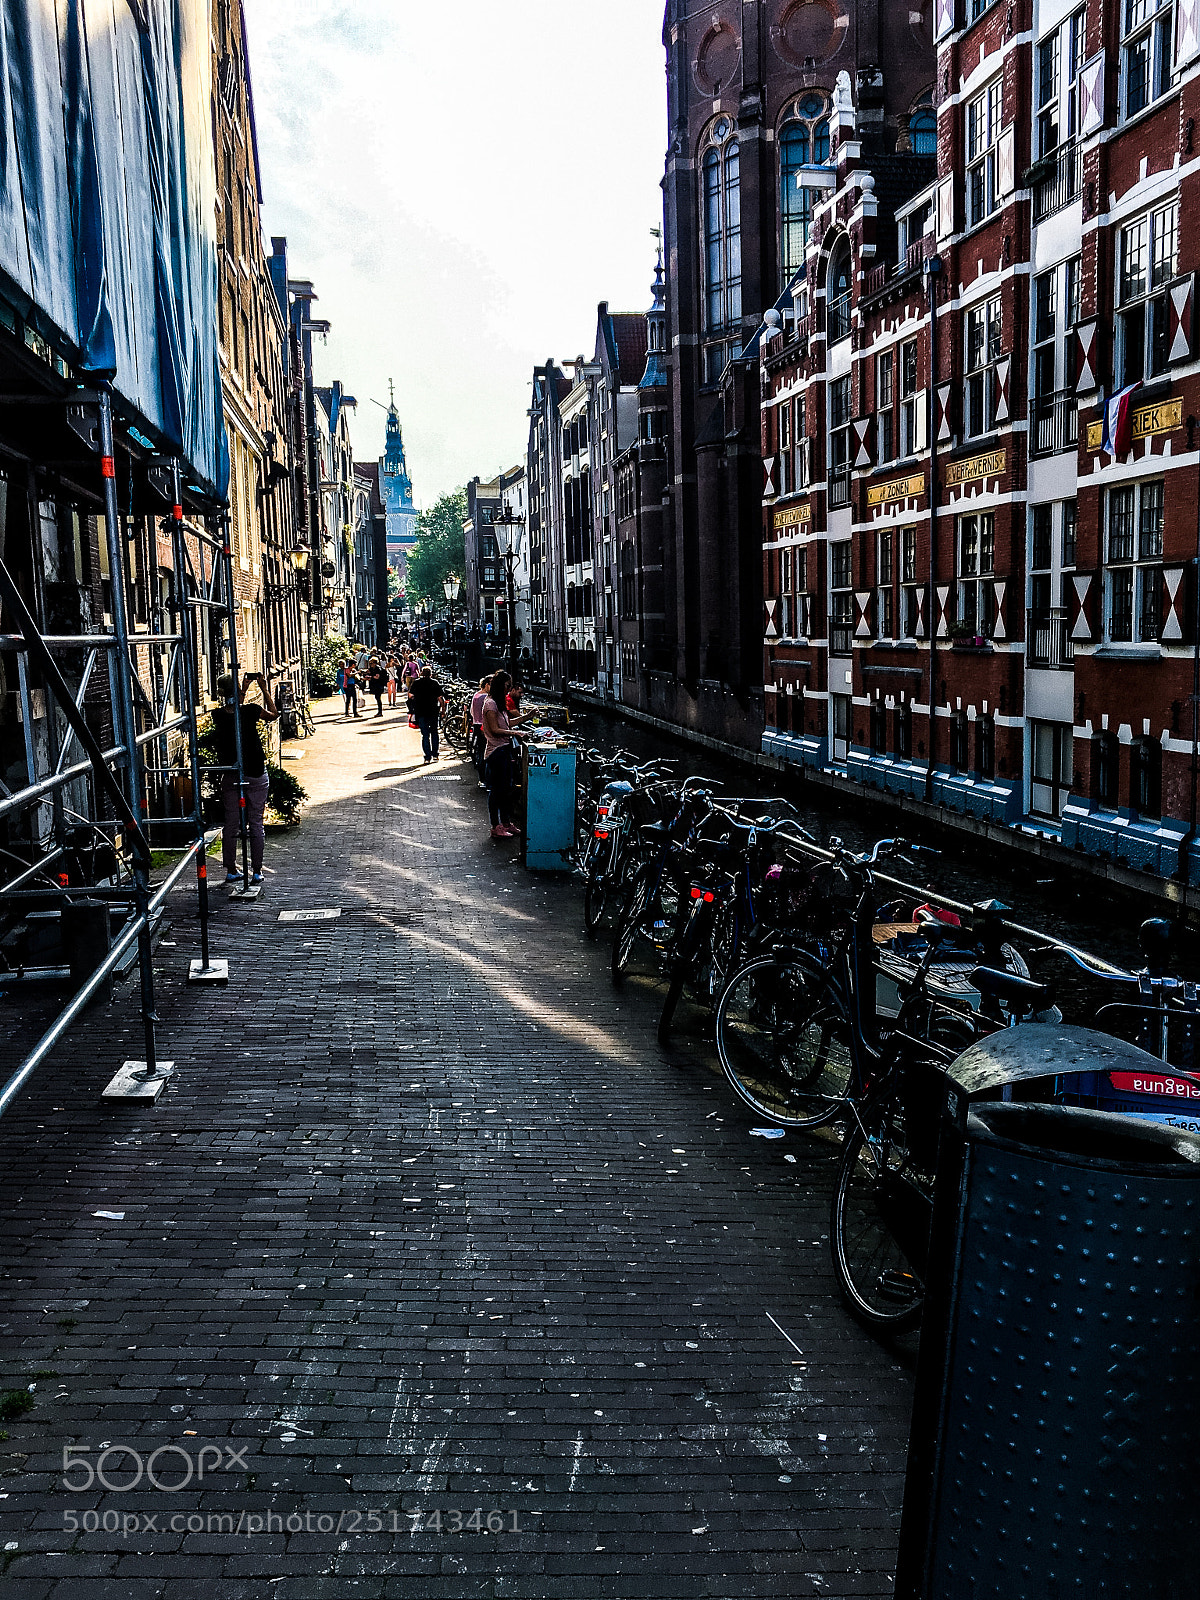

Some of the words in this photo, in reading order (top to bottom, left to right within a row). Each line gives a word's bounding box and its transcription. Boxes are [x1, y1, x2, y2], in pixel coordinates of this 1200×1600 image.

[1131, 409, 1160, 433] RIEK
[973, 454, 999, 476] VERNIS
[887, 480, 909, 498] ZONEN
[528, 755, 546, 766] J.V.
